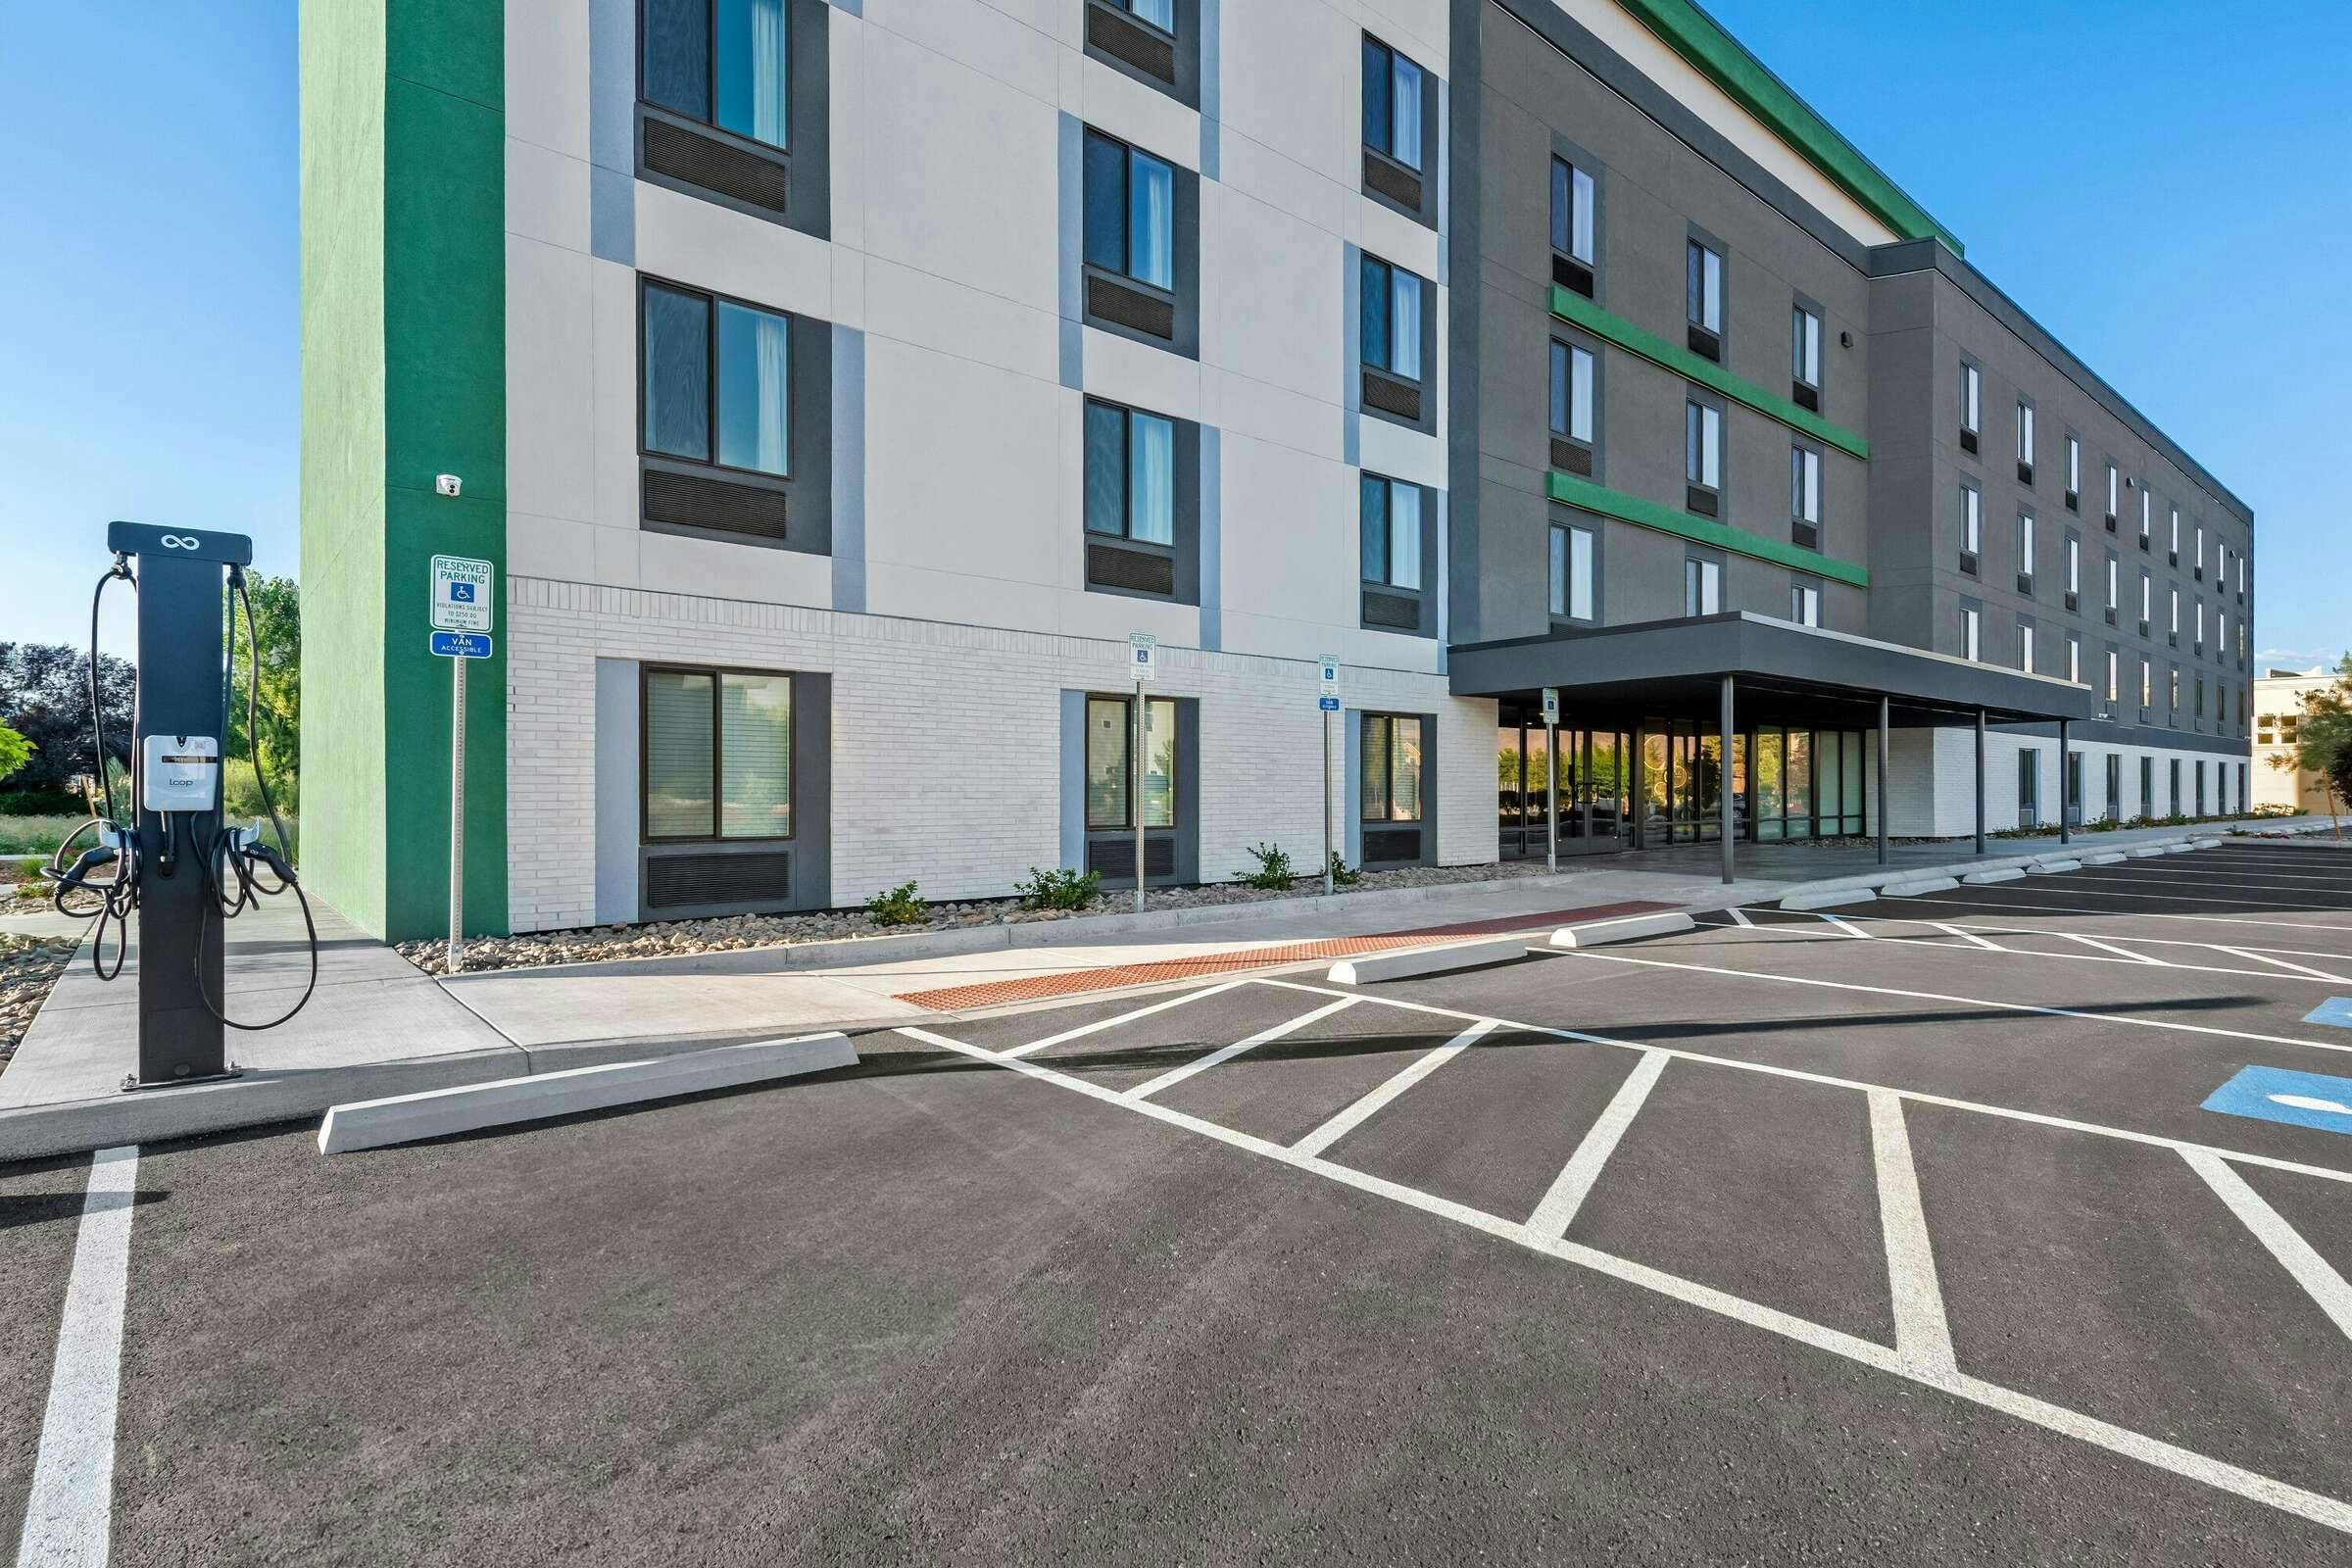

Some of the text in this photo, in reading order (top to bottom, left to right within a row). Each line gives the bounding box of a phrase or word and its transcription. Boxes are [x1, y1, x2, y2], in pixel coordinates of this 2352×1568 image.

[437, 560, 489, 574] RESERVED
[440, 570, 485, 584] PARKING
[441, 645, 483, 654] ACCESSIBLE
